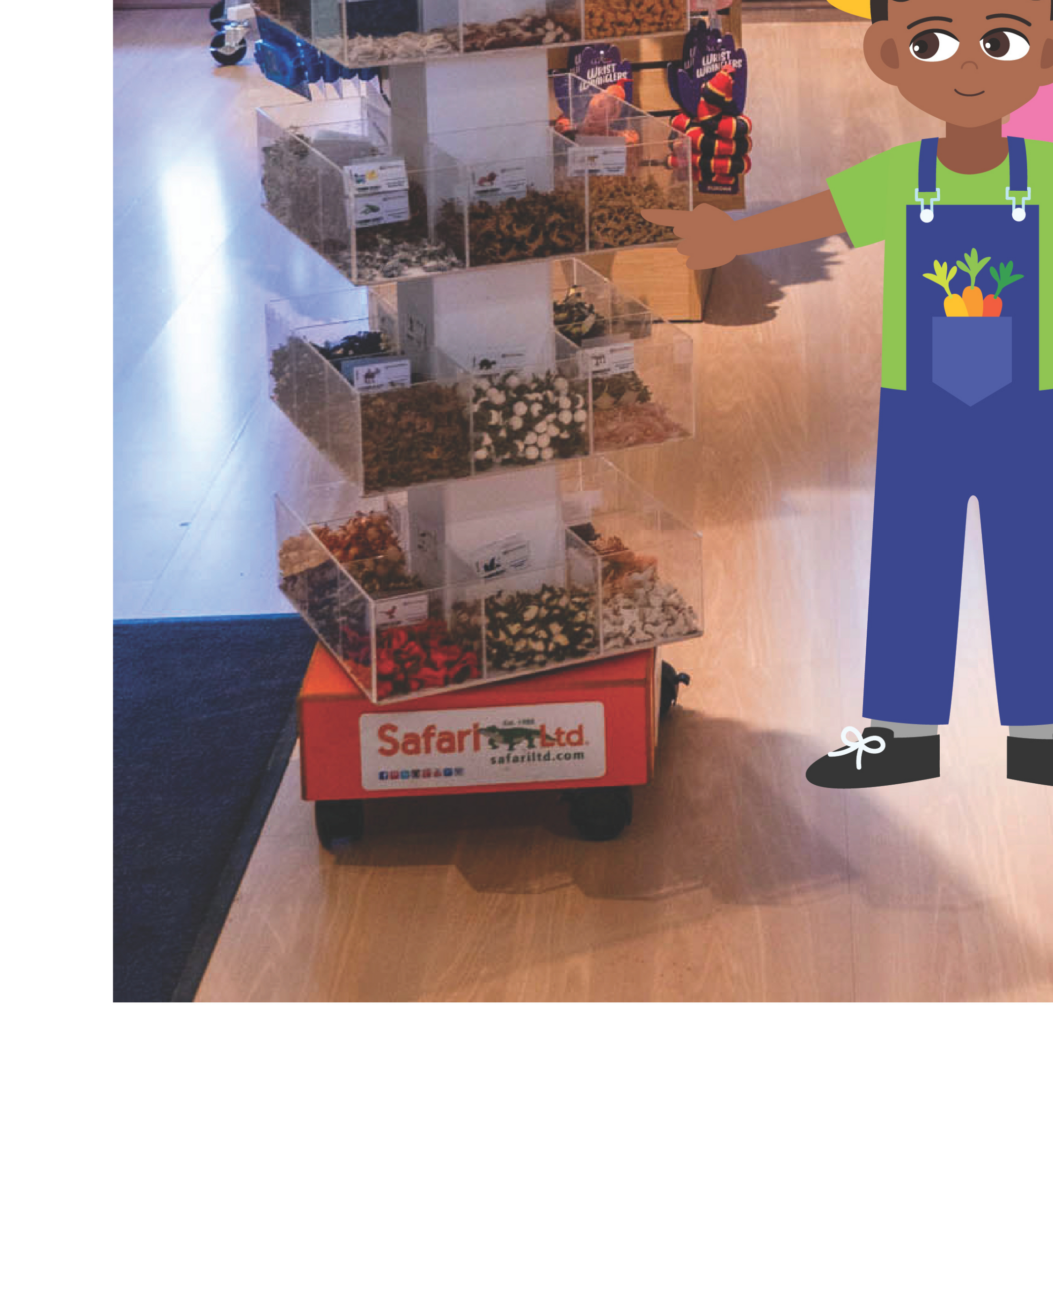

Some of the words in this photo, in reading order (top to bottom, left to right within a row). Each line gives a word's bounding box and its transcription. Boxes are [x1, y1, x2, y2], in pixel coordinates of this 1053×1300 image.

[702, 50, 731, 66] WRIST
[587, 63, 617, 80] WRIST
[378, 722, 482, 757] Safari
[490, 750, 585, 765] safariltd.com
